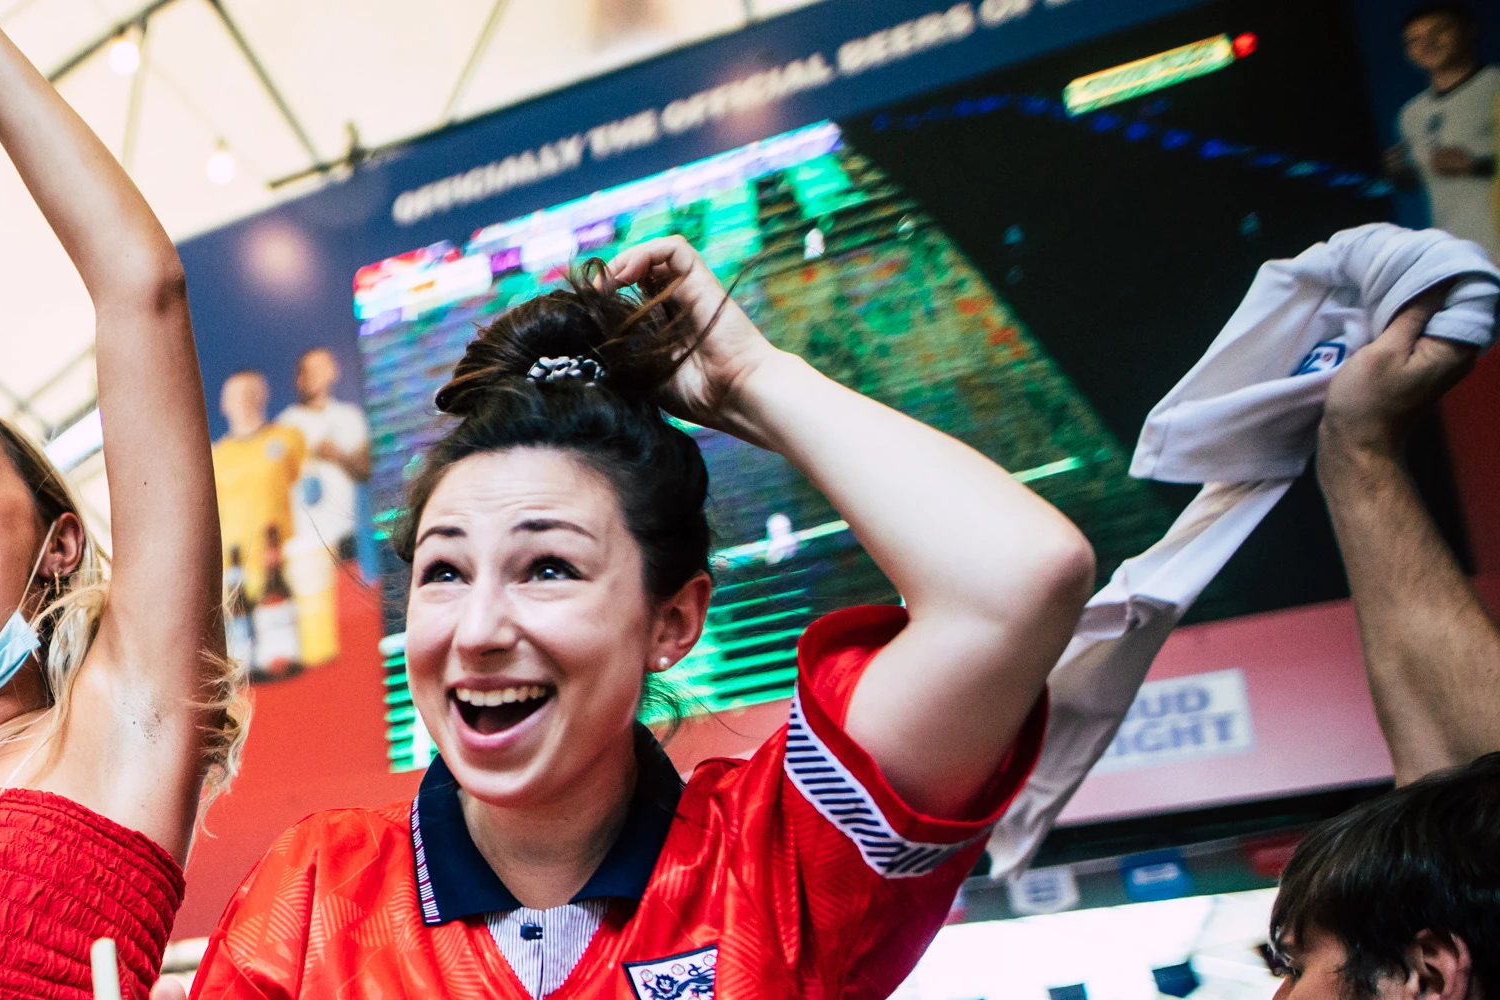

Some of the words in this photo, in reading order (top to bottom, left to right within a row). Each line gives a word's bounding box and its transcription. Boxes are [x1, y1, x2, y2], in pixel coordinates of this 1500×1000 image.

[392, 132, 583, 225] OFFICIALLY
[586, 109, 659, 160] THE
[660, 53, 833, 134] OFFICIAL
[837, 2, 976, 76] BEERS
[1125, 684, 1212, 721] UD
[1113, 712, 1235, 757] IGHT
